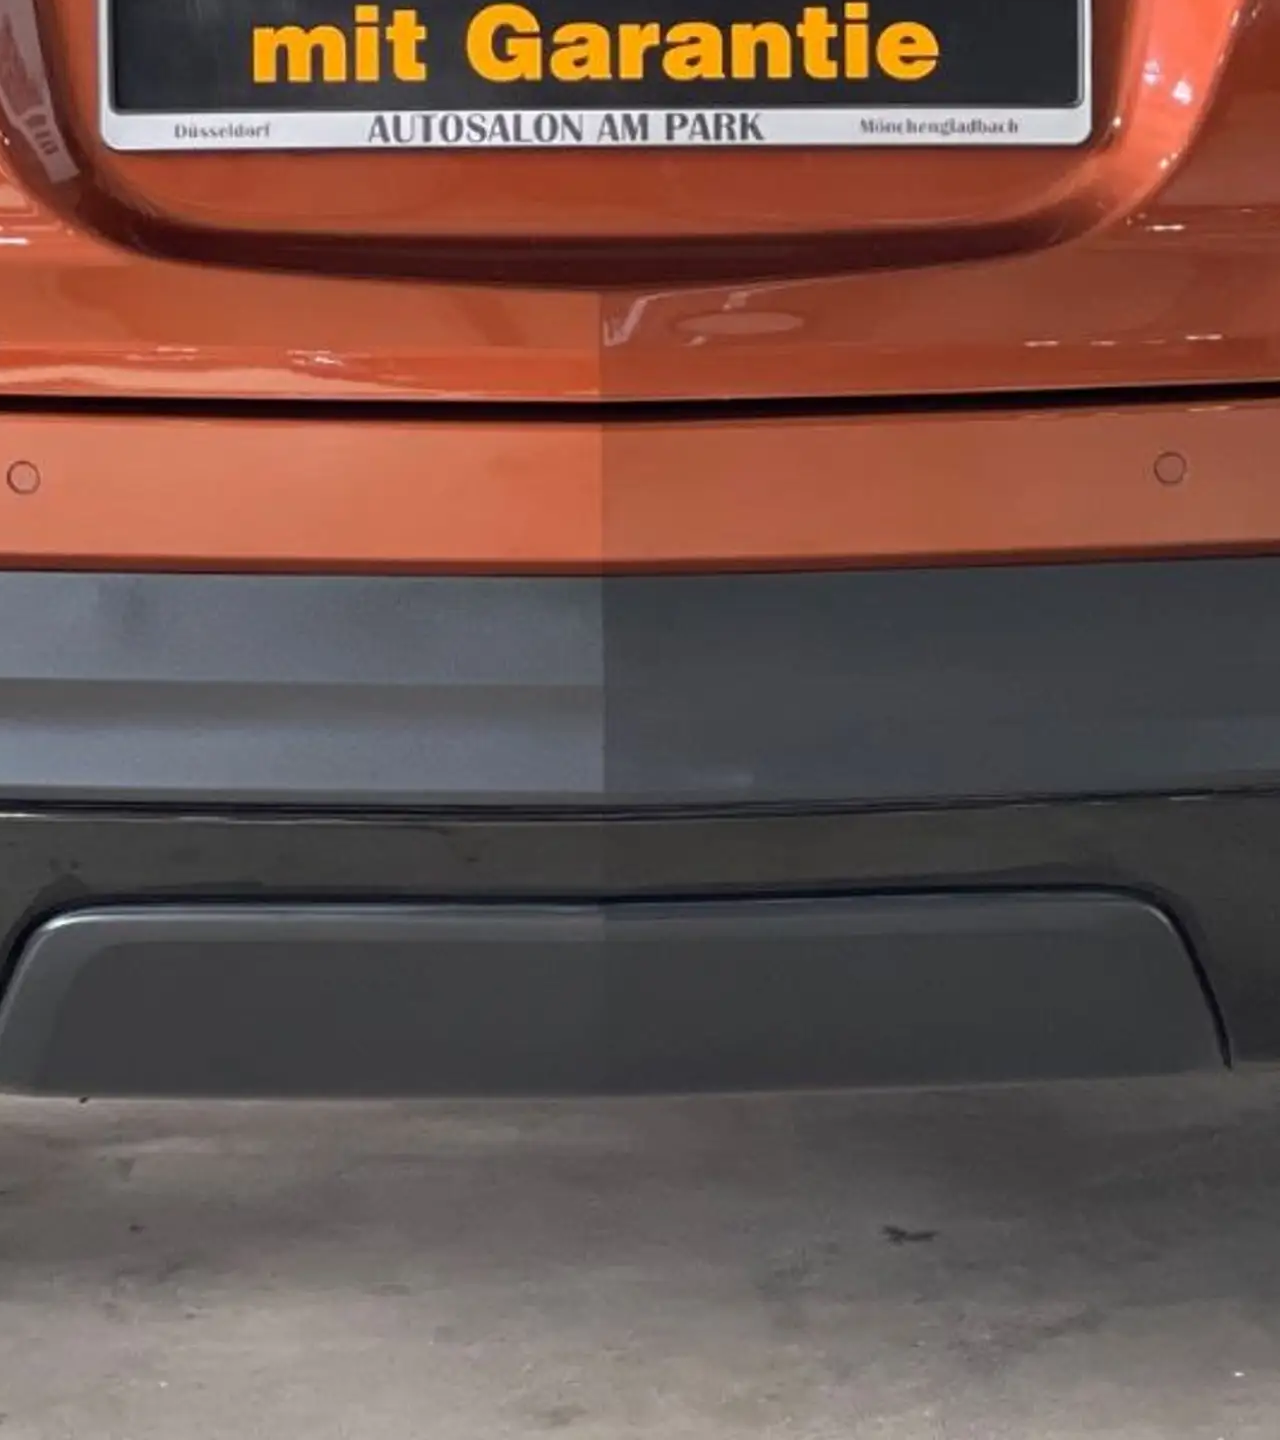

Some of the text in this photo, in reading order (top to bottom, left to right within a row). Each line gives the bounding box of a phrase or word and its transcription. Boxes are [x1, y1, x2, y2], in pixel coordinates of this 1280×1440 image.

[252, 1, 940, 83] mit Garantie
[173, 122, 272, 139] Düsseldorf
[368, 112, 765, 143] AUTOSALON AM PARK
[860, 117, 1019, 137] Mönchengladbach
